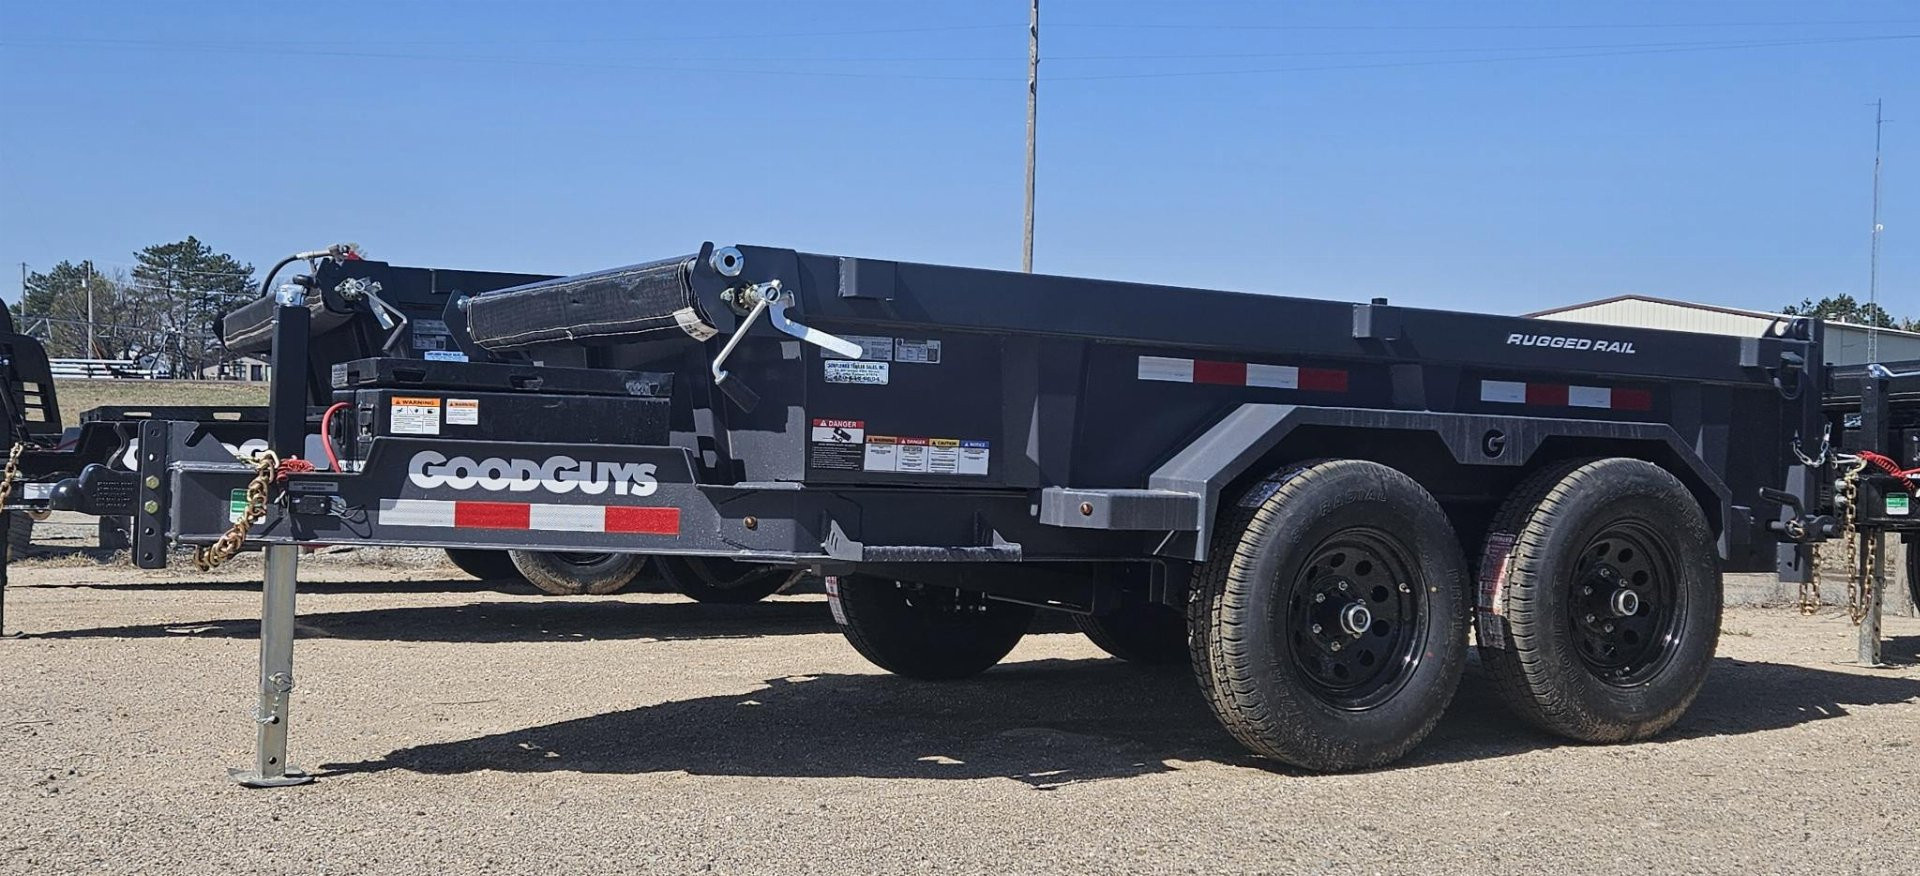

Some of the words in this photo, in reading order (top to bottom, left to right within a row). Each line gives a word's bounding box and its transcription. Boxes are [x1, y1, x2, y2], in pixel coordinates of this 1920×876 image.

[1506, 333, 1592, 350] RUGGED
[1593, 340, 1636, 354] RAIL
[828, 420, 857, 428] DANGER
[408, 450, 658, 497] GOODGUYS
